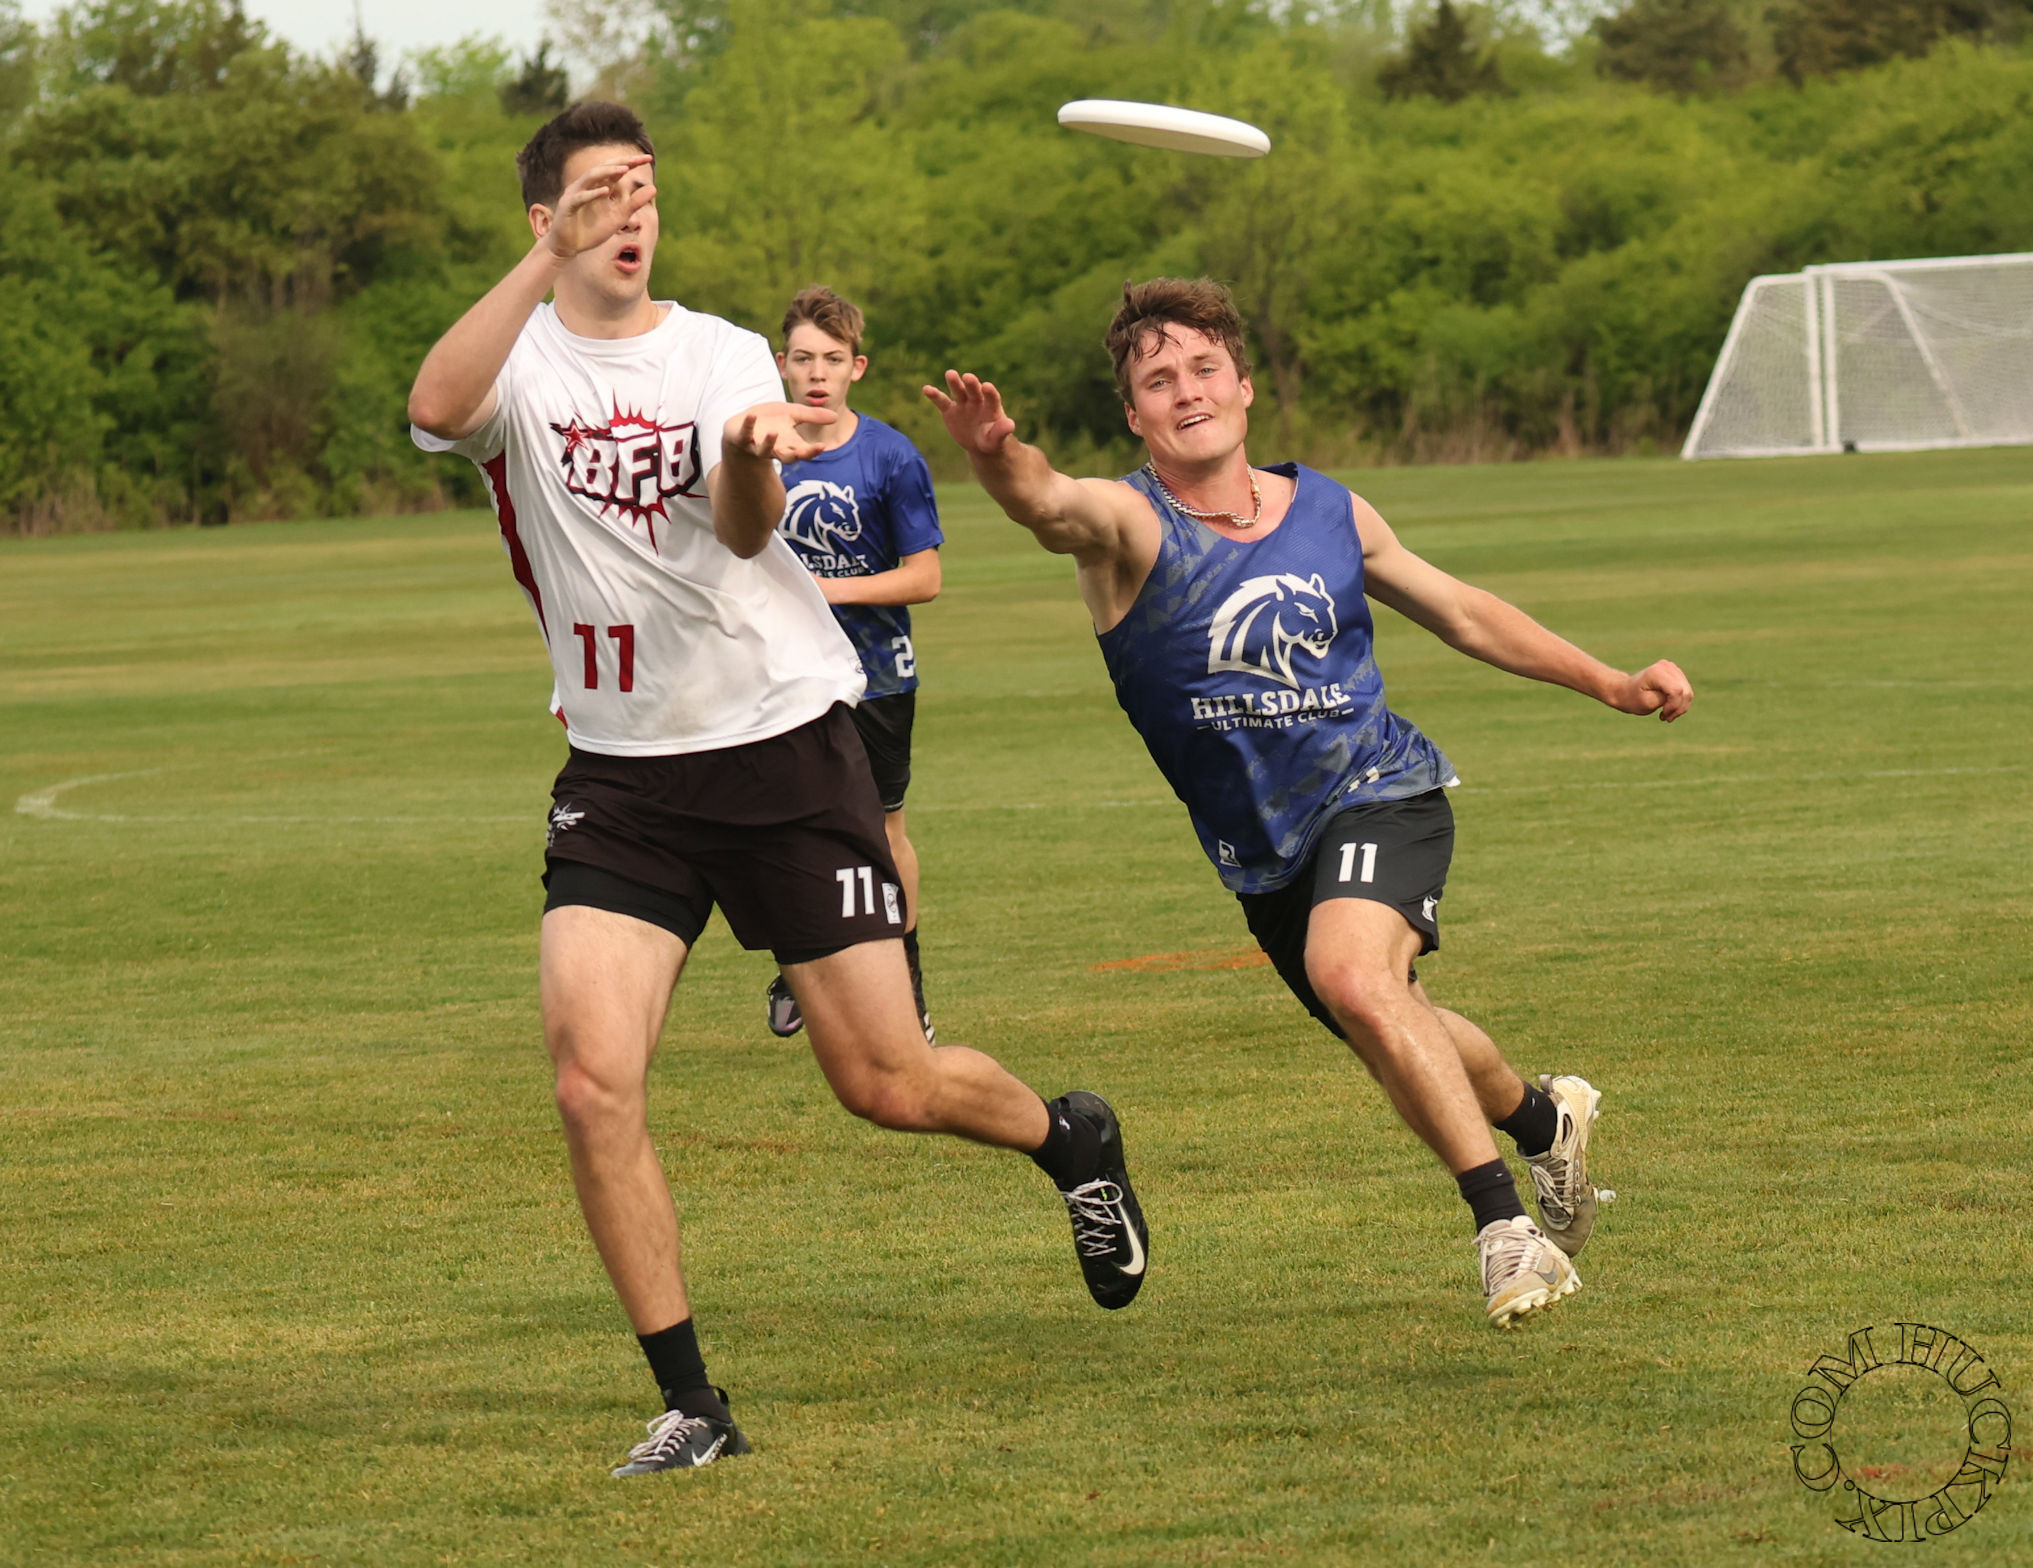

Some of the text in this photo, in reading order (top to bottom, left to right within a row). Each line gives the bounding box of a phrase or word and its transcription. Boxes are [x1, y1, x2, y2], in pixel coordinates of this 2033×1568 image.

[573, 622, 634, 693] 11
[1190, 682, 1352, 720] HILLSDALE
[1211, 709, 1339, 731] ULTIMATE CLUB
[1338, 842, 1378, 883] 11
[836, 866, 876, 918] 11
